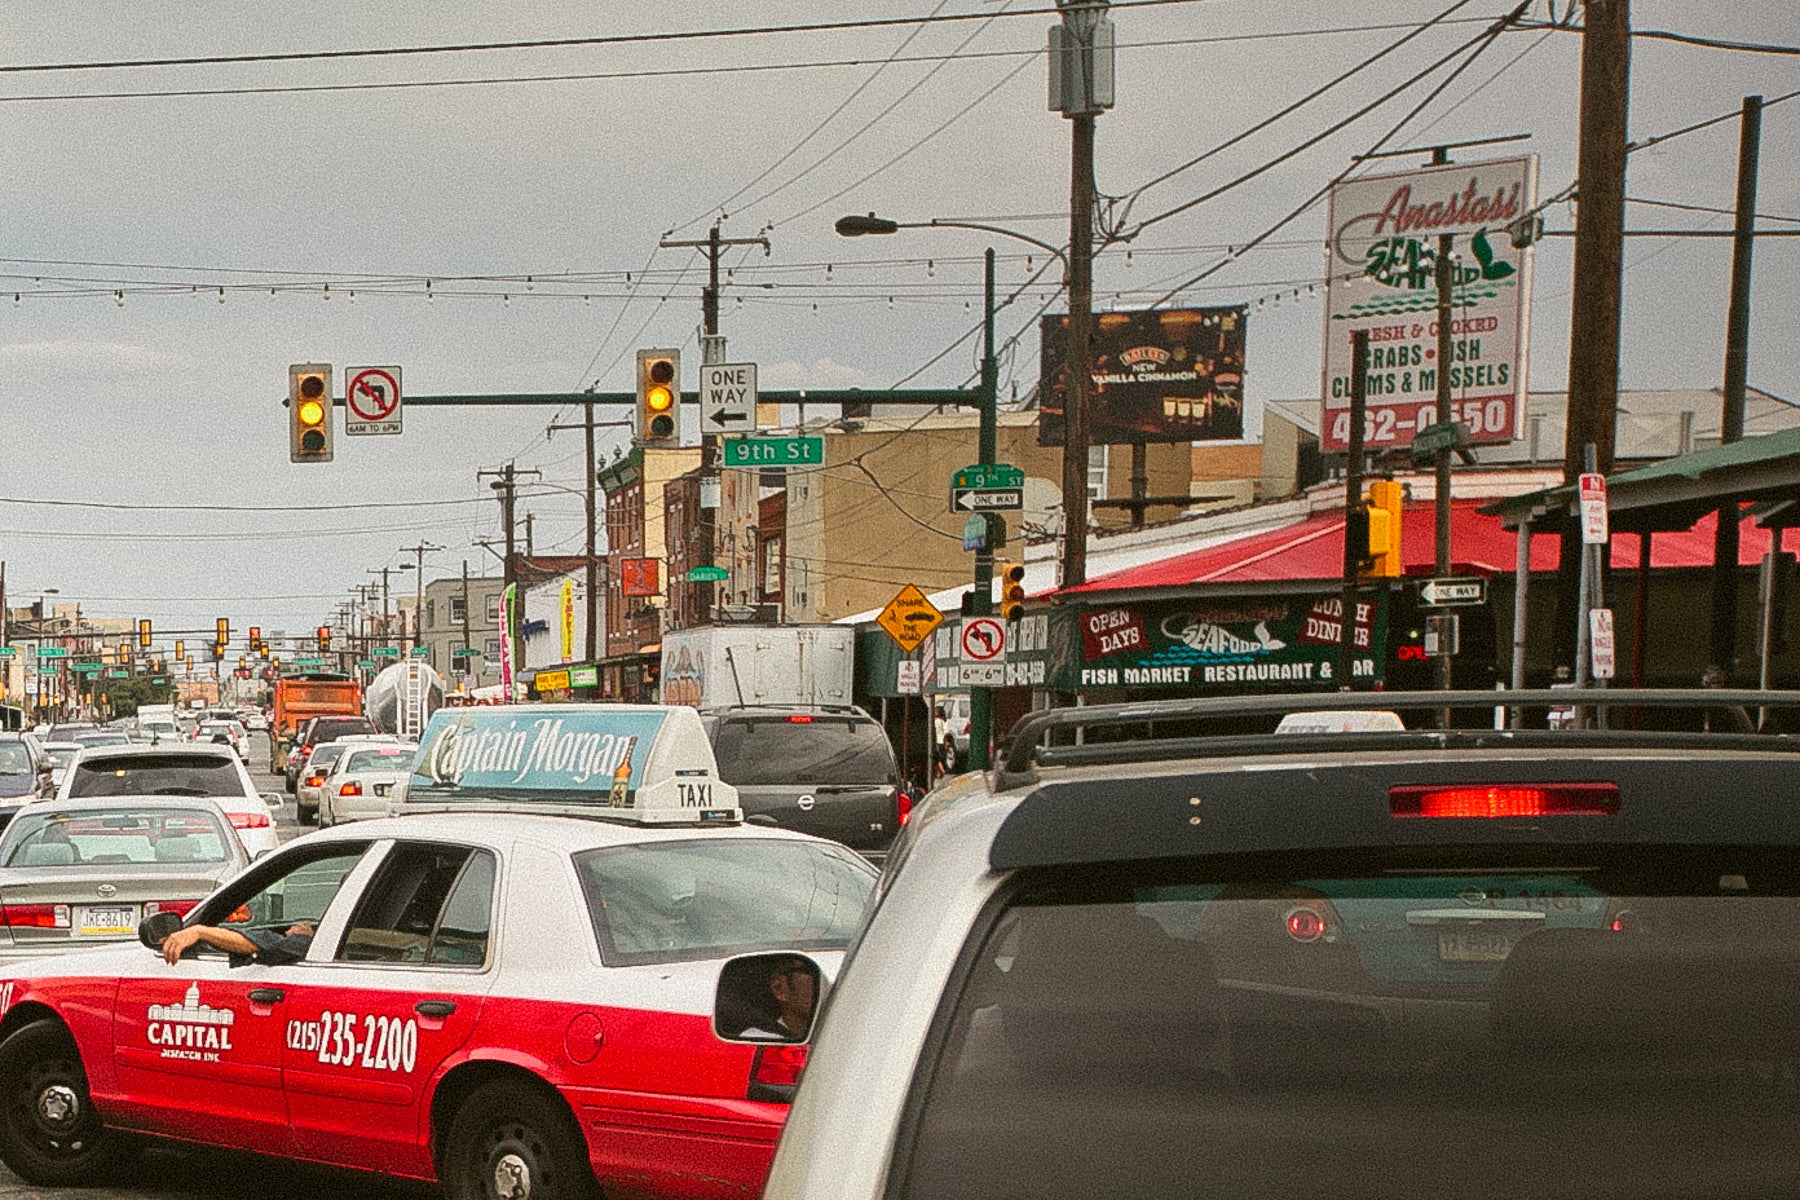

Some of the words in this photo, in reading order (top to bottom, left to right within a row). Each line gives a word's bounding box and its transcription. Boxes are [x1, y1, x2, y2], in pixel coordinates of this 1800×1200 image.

[1372, 177, 1520, 236] Anastasi
[711, 370, 746, 386] ONE
[1092, 373, 1136, 384] VANILLA
[1138, 371, 1197, 382] CINNAMON
[1132, 363, 1156, 372] NEW
[1332, 373, 1396, 399] CLMS
[1401, 371, 1413, 393] &
[1419, 363, 1509, 392] MSSELS
[710, 388, 747, 404] WAY
[736, 443, 776, 461] 9th
[787, 442, 811, 459] St
[974, 496, 993, 505] ONE
[996, 495, 1016, 504] WAY
[897, 599, 924, 608] SHARE
[903, 624, 917, 632] THE
[1089, 610, 1130, 634] OPEN
[1100, 627, 1140, 653] DAYS
[1081, 669, 1118, 685] FISH
[1124, 667, 1192, 684] MARKET
[1204, 663, 1314, 682] RESTAURANT
[1320, 661, 1333, 678] &
[1352, 659, 1374, 676] AR
[429, 719, 528, 785] Captain
[511, 717, 633, 784] Morgan
[676, 784, 712, 808] TAXI
[147, 1022, 233, 1050] CAPITAL
[286, 1020, 322, 1051] (215)
[318, 1010, 417, 1073] 235-2200
[161, 1048, 201, 1060] DISPATCH
